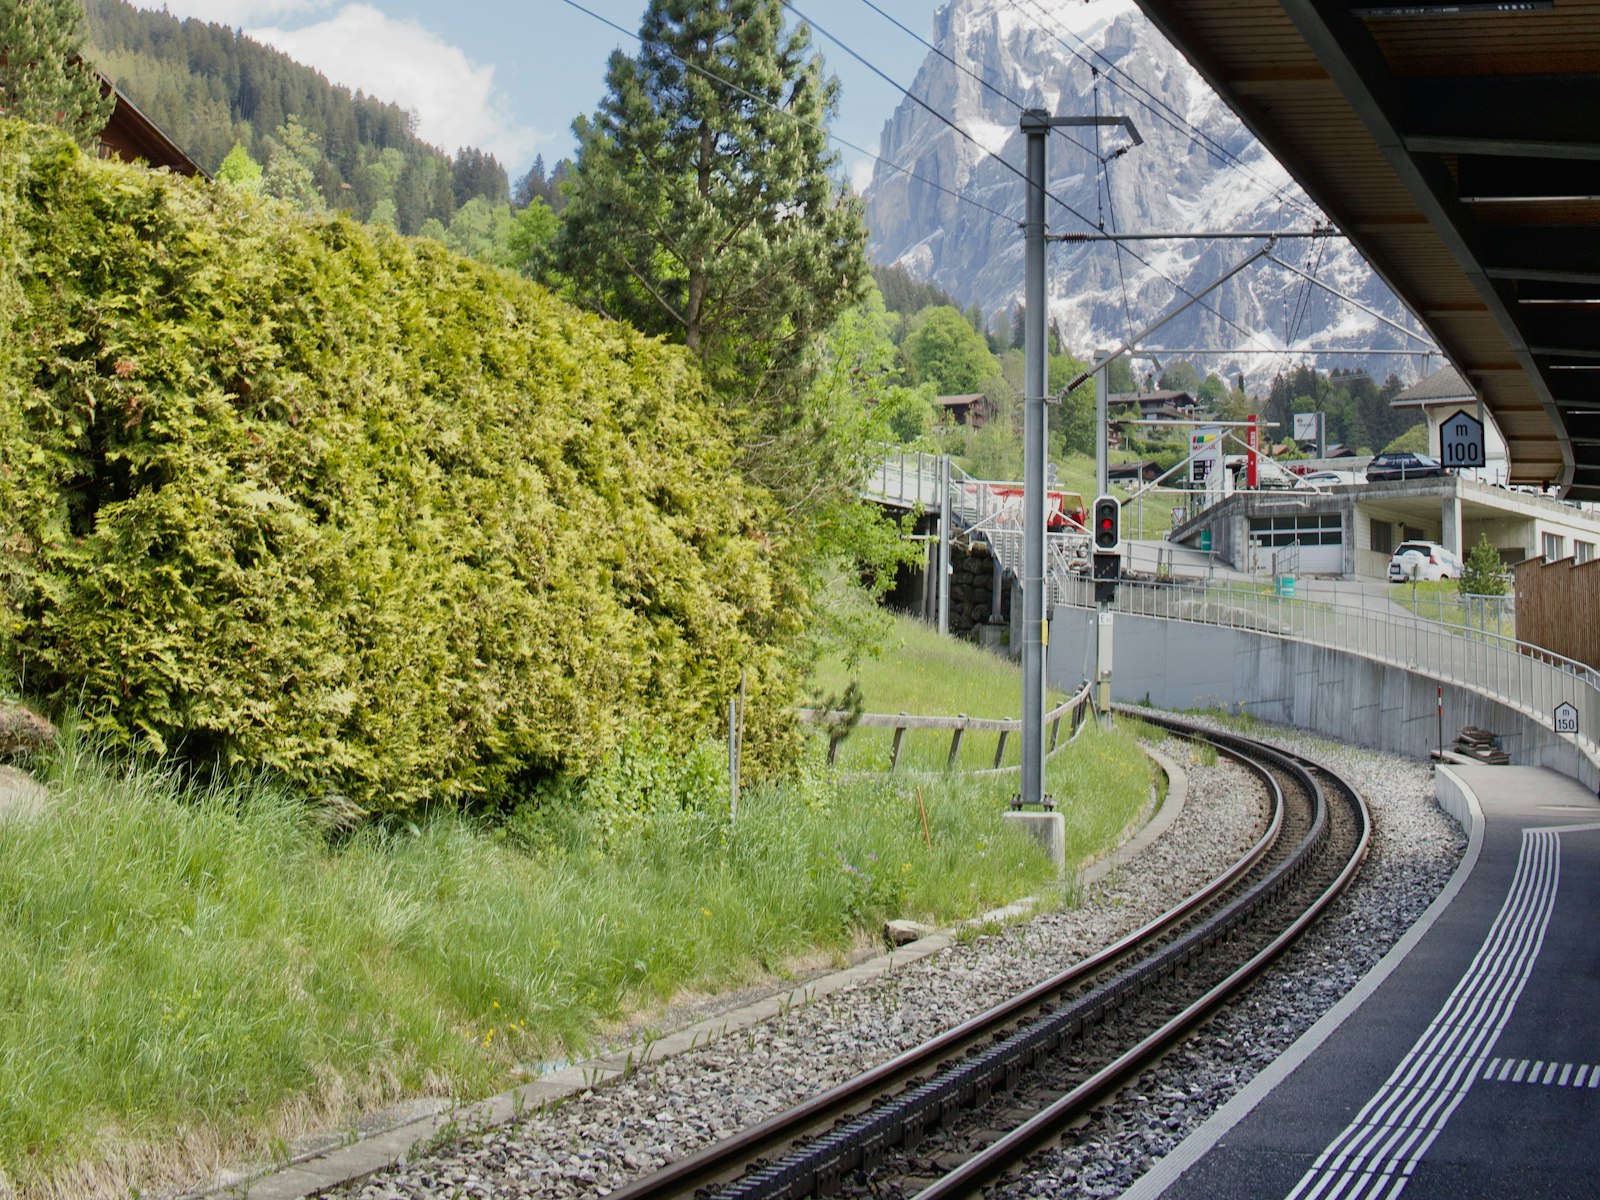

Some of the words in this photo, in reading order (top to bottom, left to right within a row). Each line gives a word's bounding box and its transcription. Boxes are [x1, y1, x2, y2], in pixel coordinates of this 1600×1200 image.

[1456, 424, 1468, 436] m
[1447, 442, 1478, 461] 100
[1558, 719, 1575, 730] 150
